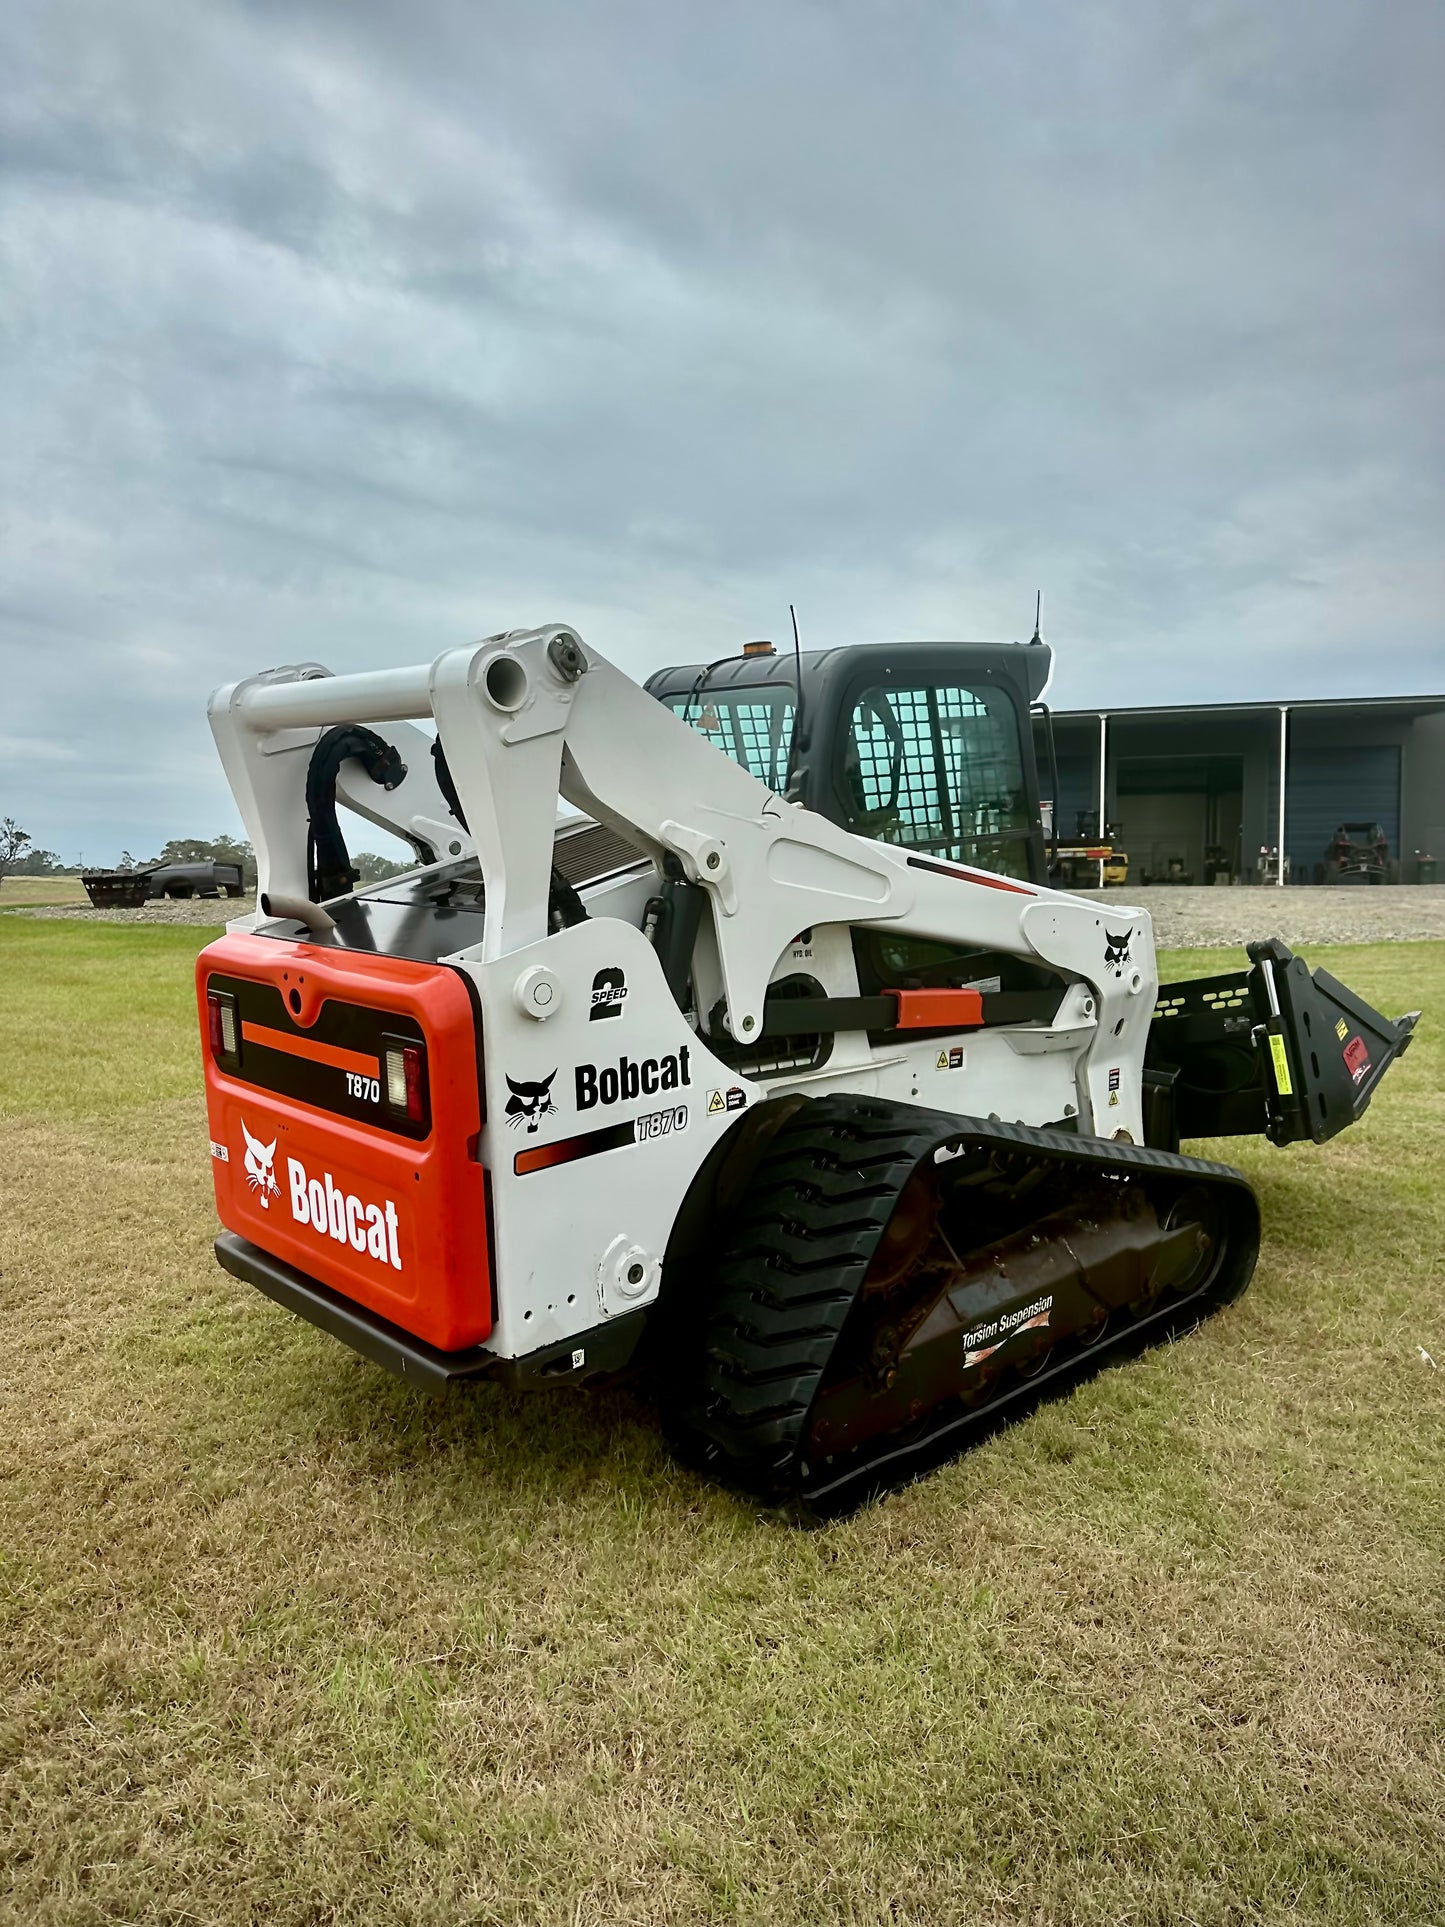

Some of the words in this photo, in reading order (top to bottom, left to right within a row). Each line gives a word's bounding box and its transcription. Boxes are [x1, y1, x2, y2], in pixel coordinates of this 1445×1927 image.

[804, 949, 813, 957] OIL
[589, 966, 625, 1022] 2
[591, 988, 628, 1003] SPEED
[346, 1072, 380, 1103] T870
[575, 1045, 691, 1111] Bobcat
[637, 1105, 688, 1141] T870
[287, 1156, 402, 1271] Bobcat
[962, 1321, 998, 1350] Torsion
[999, 1295, 1053, 1332] Suspension
